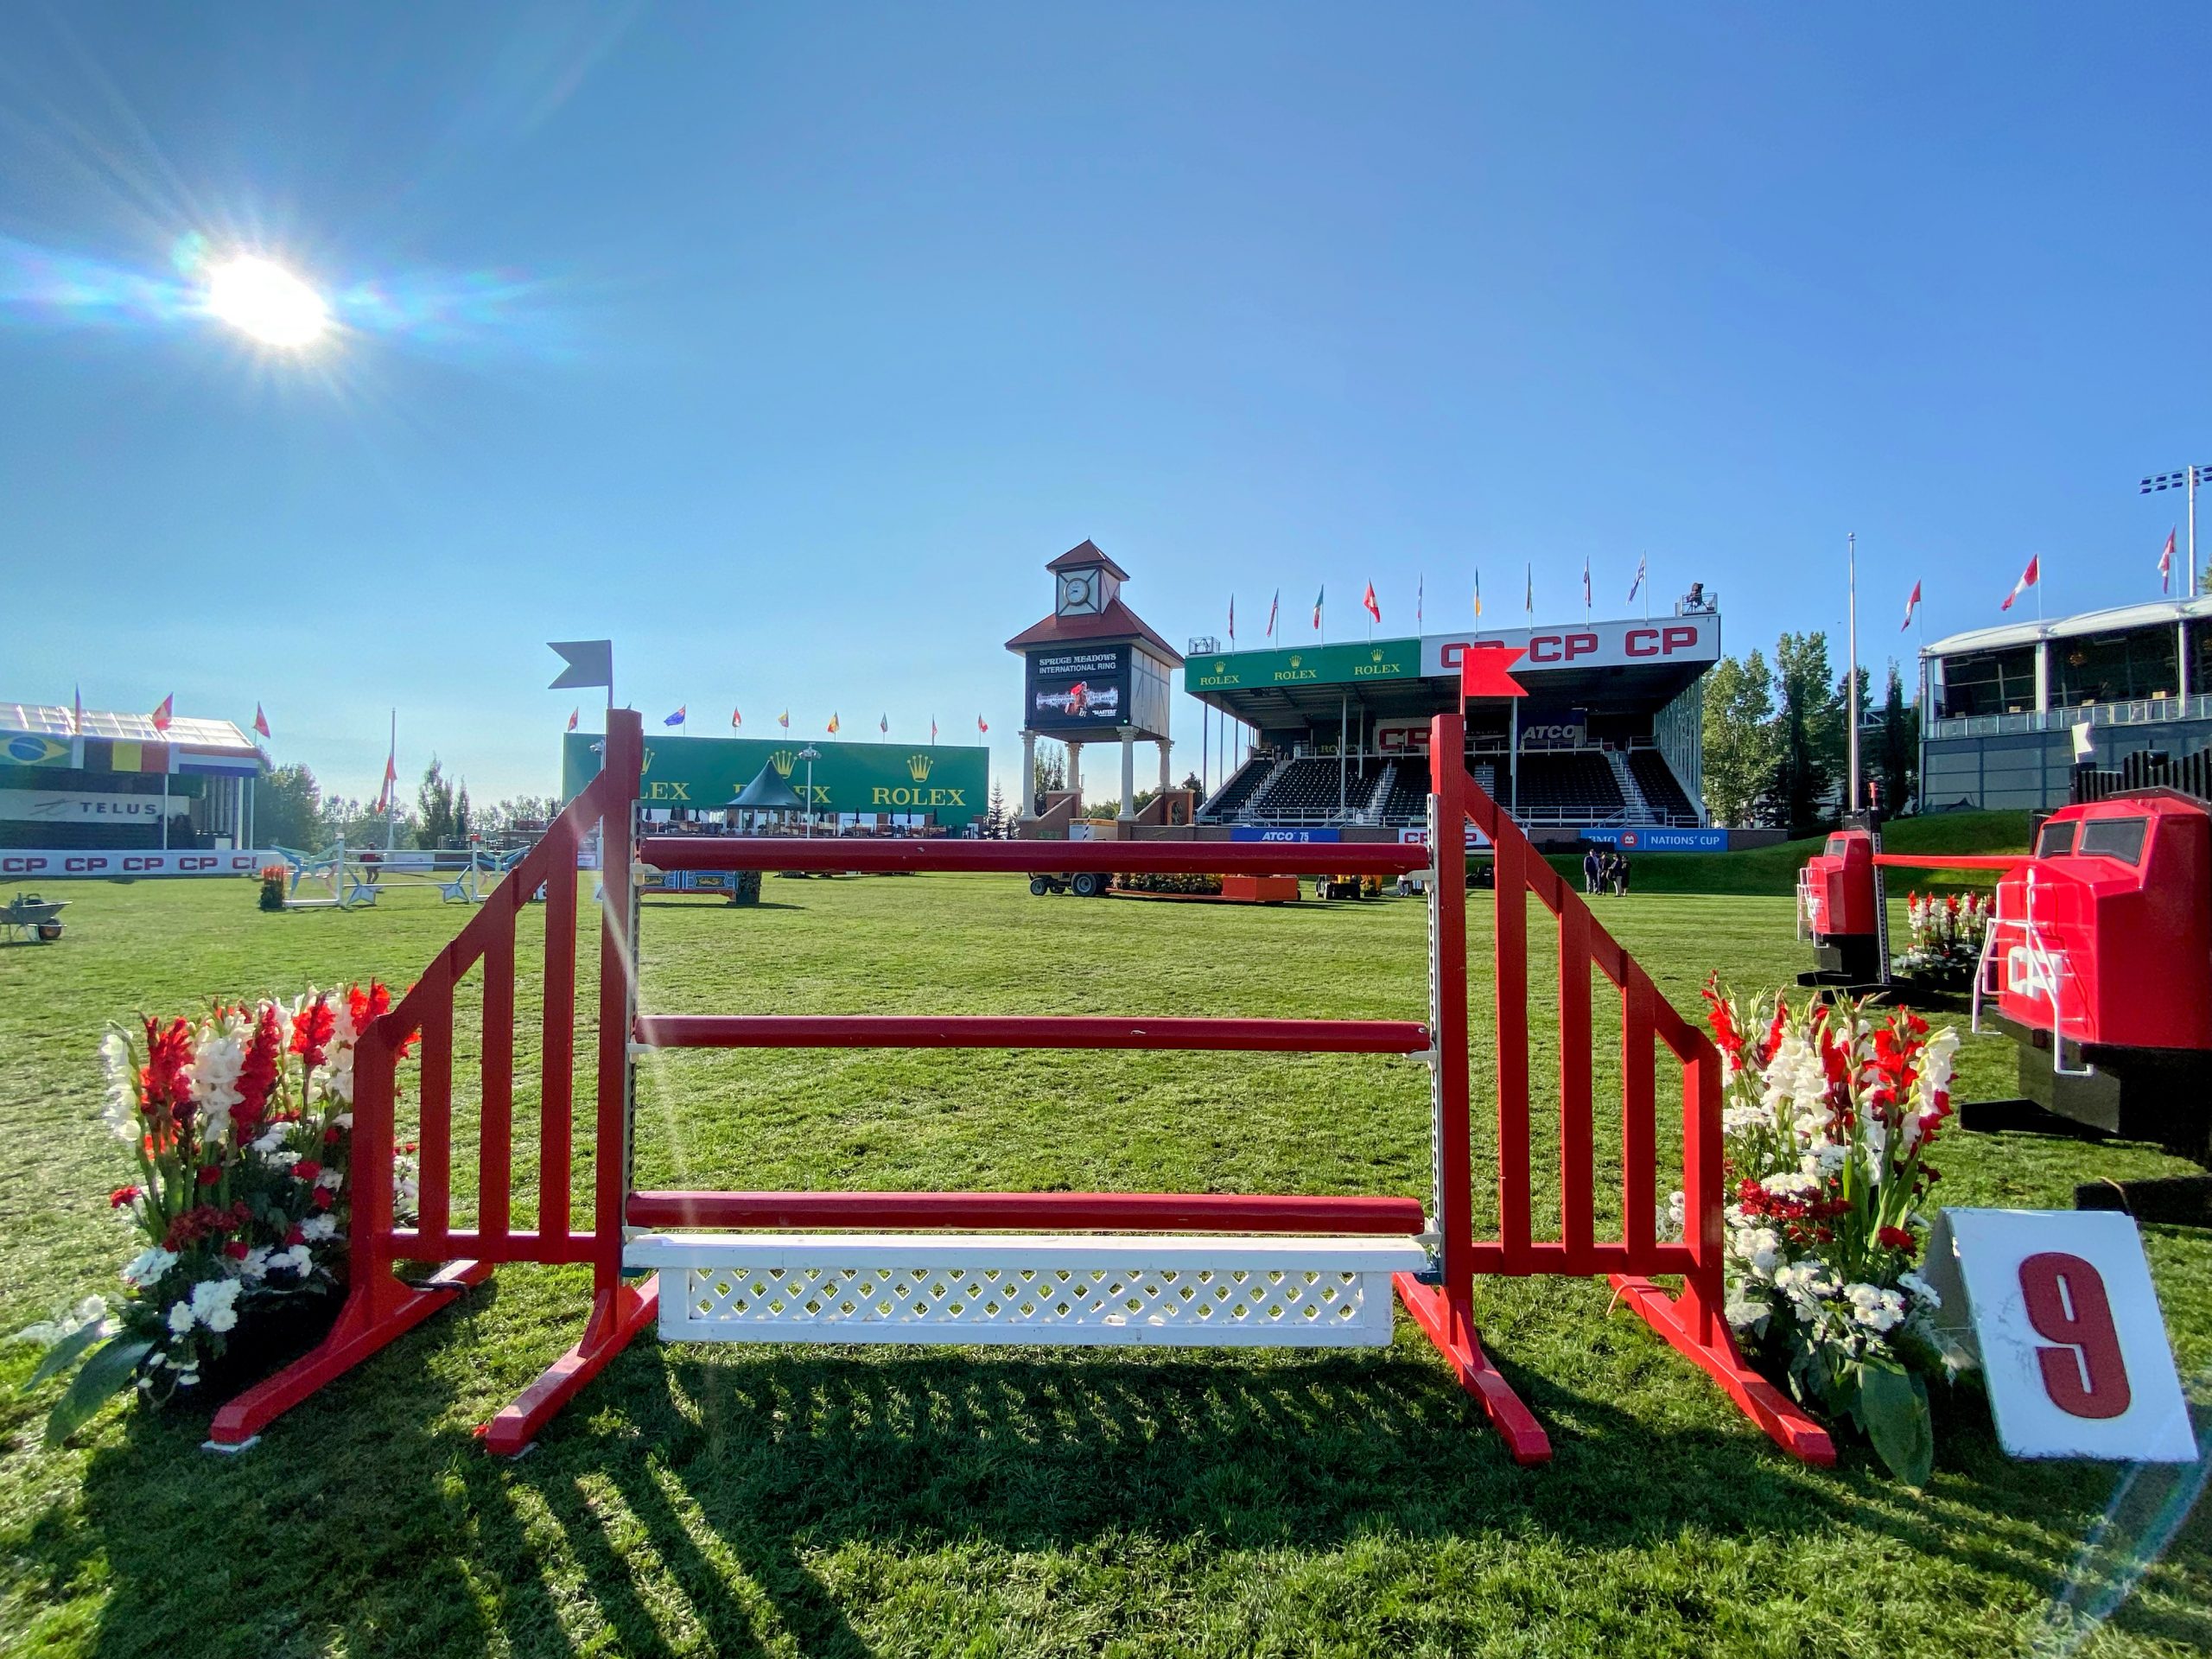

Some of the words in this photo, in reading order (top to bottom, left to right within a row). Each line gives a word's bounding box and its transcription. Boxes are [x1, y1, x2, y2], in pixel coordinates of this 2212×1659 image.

[1440, 640, 1504, 669] C
[1529, 633, 1598, 663] CP
[1625, 626, 1697, 657] CP
[1073, 653, 1116, 664] MEADOWS
[1039, 664, 1096, 674] INTERNATIONAL
[1355, 664, 1400, 676] ROLEX
[1200, 675, 1240, 686] ROLEX
[1274, 670, 1317, 681] ROLEX
[1522, 725, 1575, 740] ATCO
[872, 787, 966, 806] ROLEX
[79, 802, 157, 815] TELUS
[1262, 832, 1294, 842] ATCO
[1300, 832, 1309, 842] 75
[1700, 836, 1719, 845] CUP
[3, 858, 48, 872] CP
[65, 858, 108, 872] CP
[123, 857, 164, 871] CP
[179, 857, 218, 870] CP
[2018, 1252, 2131, 1419] 9
